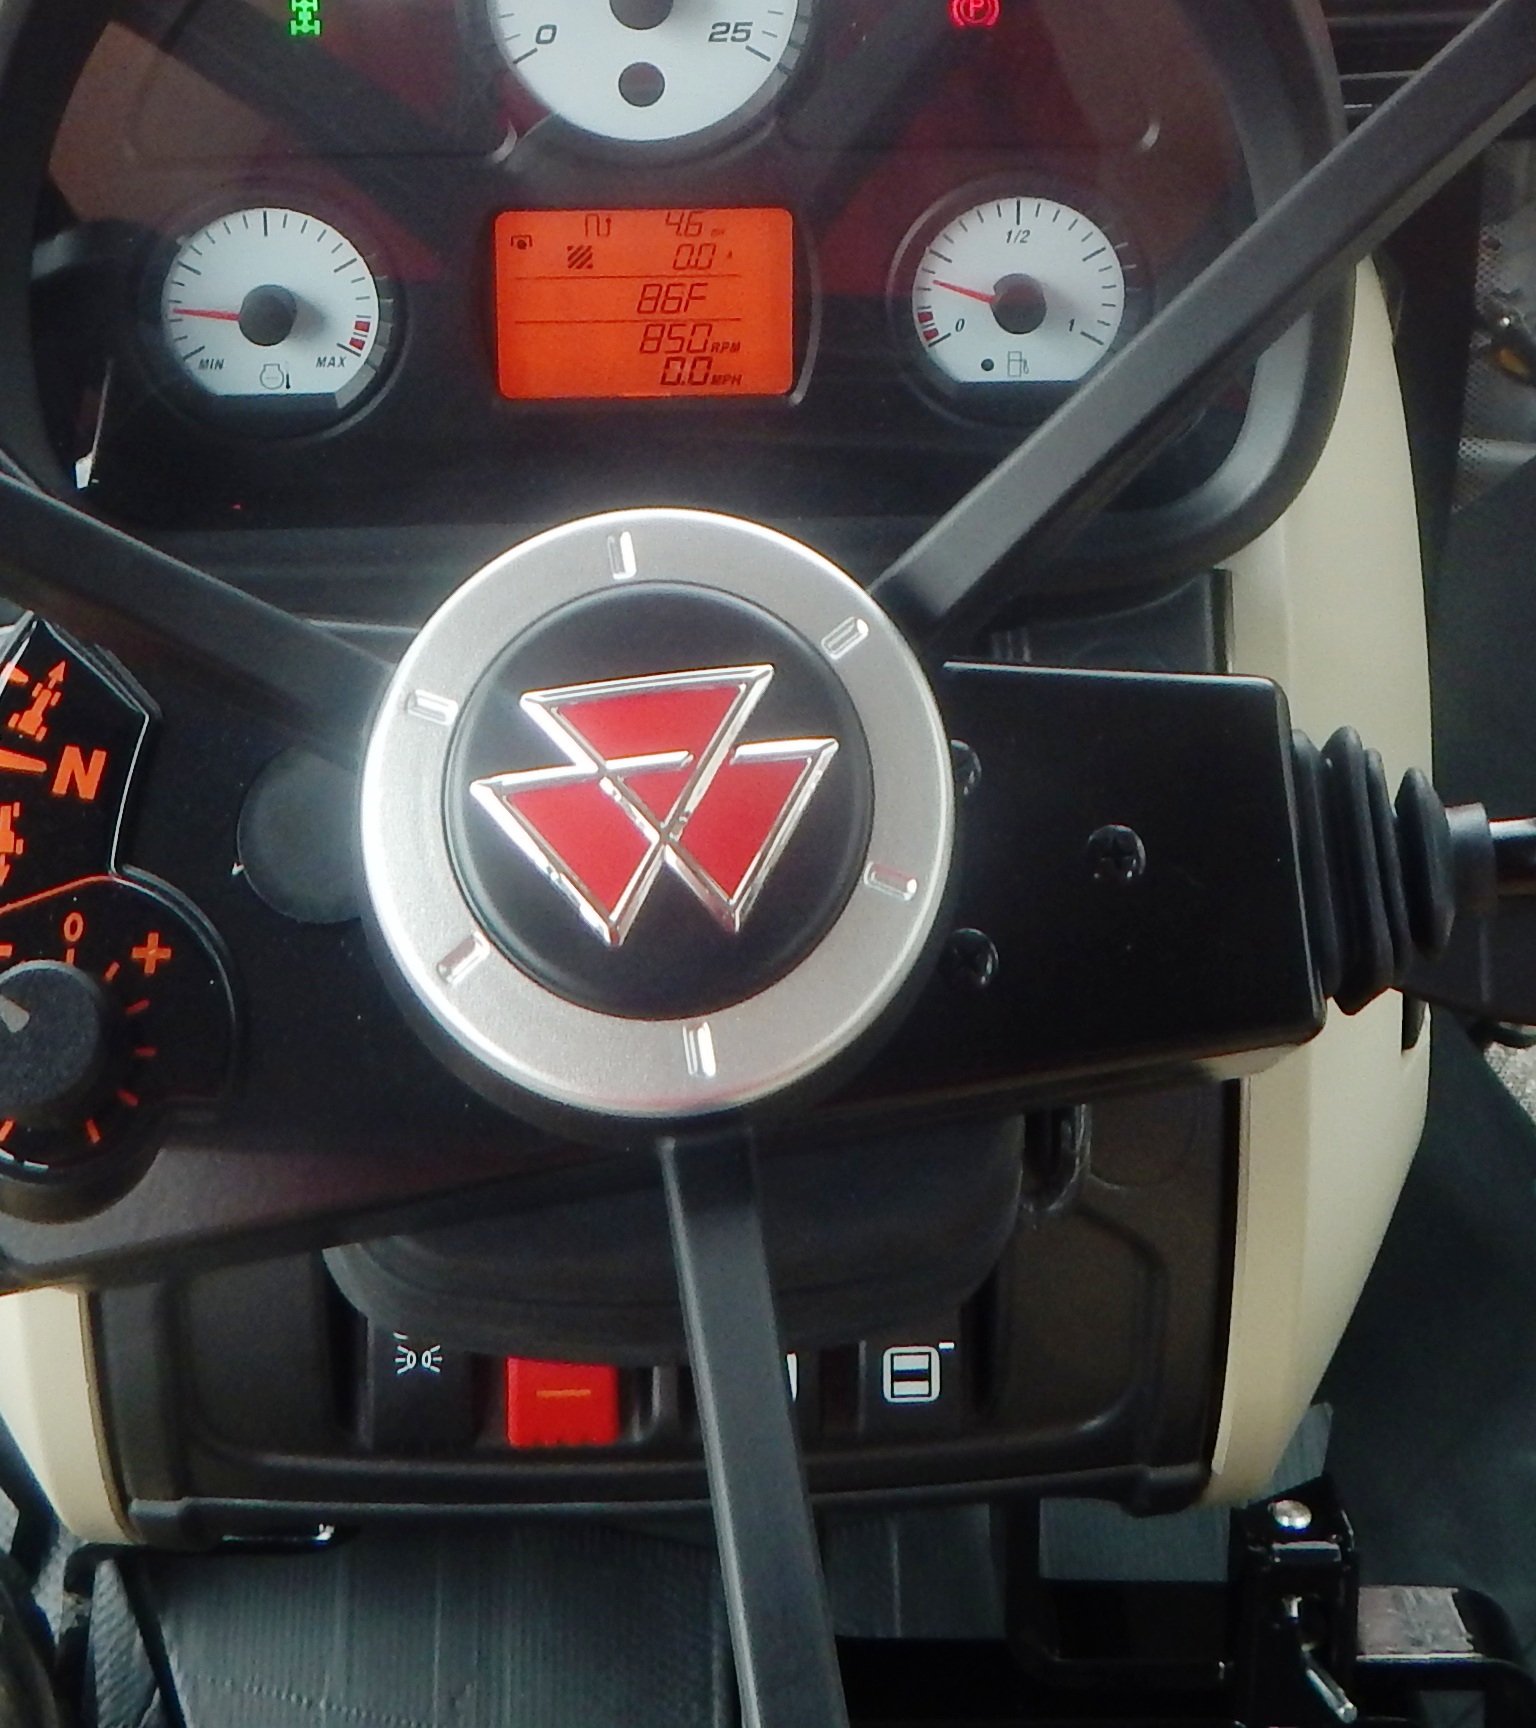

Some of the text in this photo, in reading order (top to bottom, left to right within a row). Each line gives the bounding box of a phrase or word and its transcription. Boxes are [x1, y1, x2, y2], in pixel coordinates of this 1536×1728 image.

[535, 24, 557, 45] 0
[708, 22, 753, 43] 25
[1006, 229, 1031, 244] 1/2
[955, 318, 966, 332] 0
[1068, 318, 1076, 332] 1
[639, 323, 741, 354] 850 RPM
[199, 358, 225, 370] MIN
[316, 356, 347, 368] MAX
[660, 356, 743, 386] 0.0 MPH
[52, 745, 107, 800] N
[64, 912, 85, 943] 0
